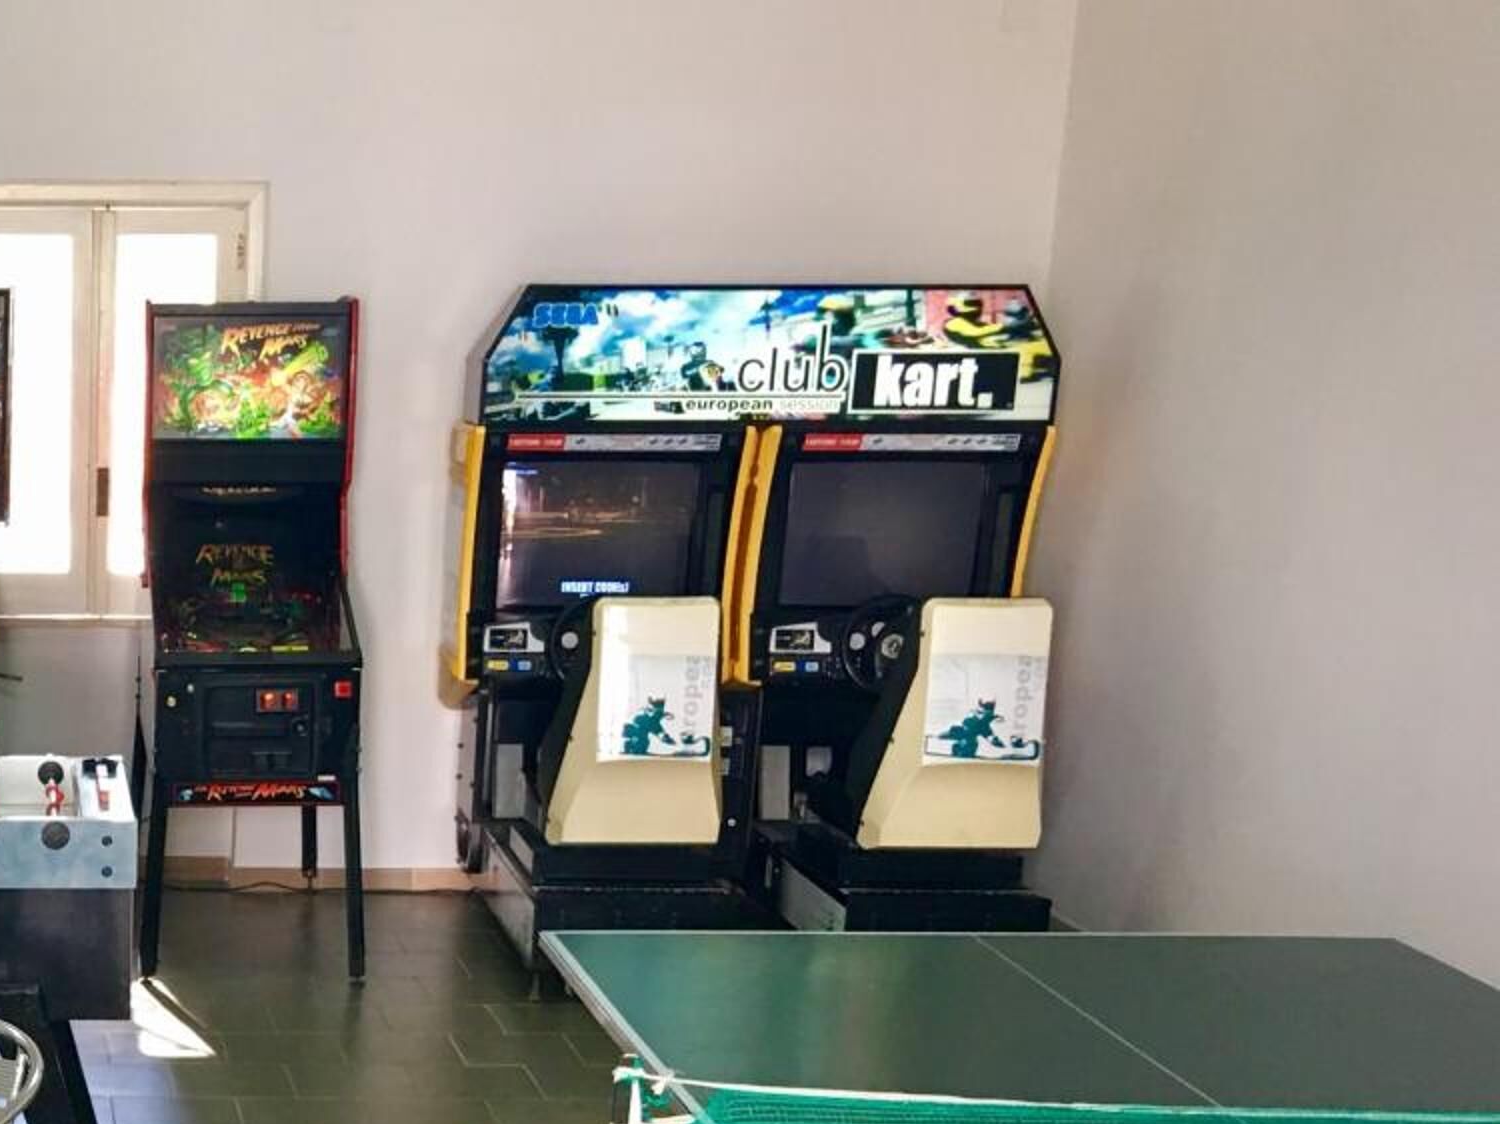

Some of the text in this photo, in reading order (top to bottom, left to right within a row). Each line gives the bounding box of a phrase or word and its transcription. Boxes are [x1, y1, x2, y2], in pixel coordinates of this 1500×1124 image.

[531, 302, 599, 329] SEGA
[738, 323, 994, 408] club kart.
[686, 400, 774, 412] european
